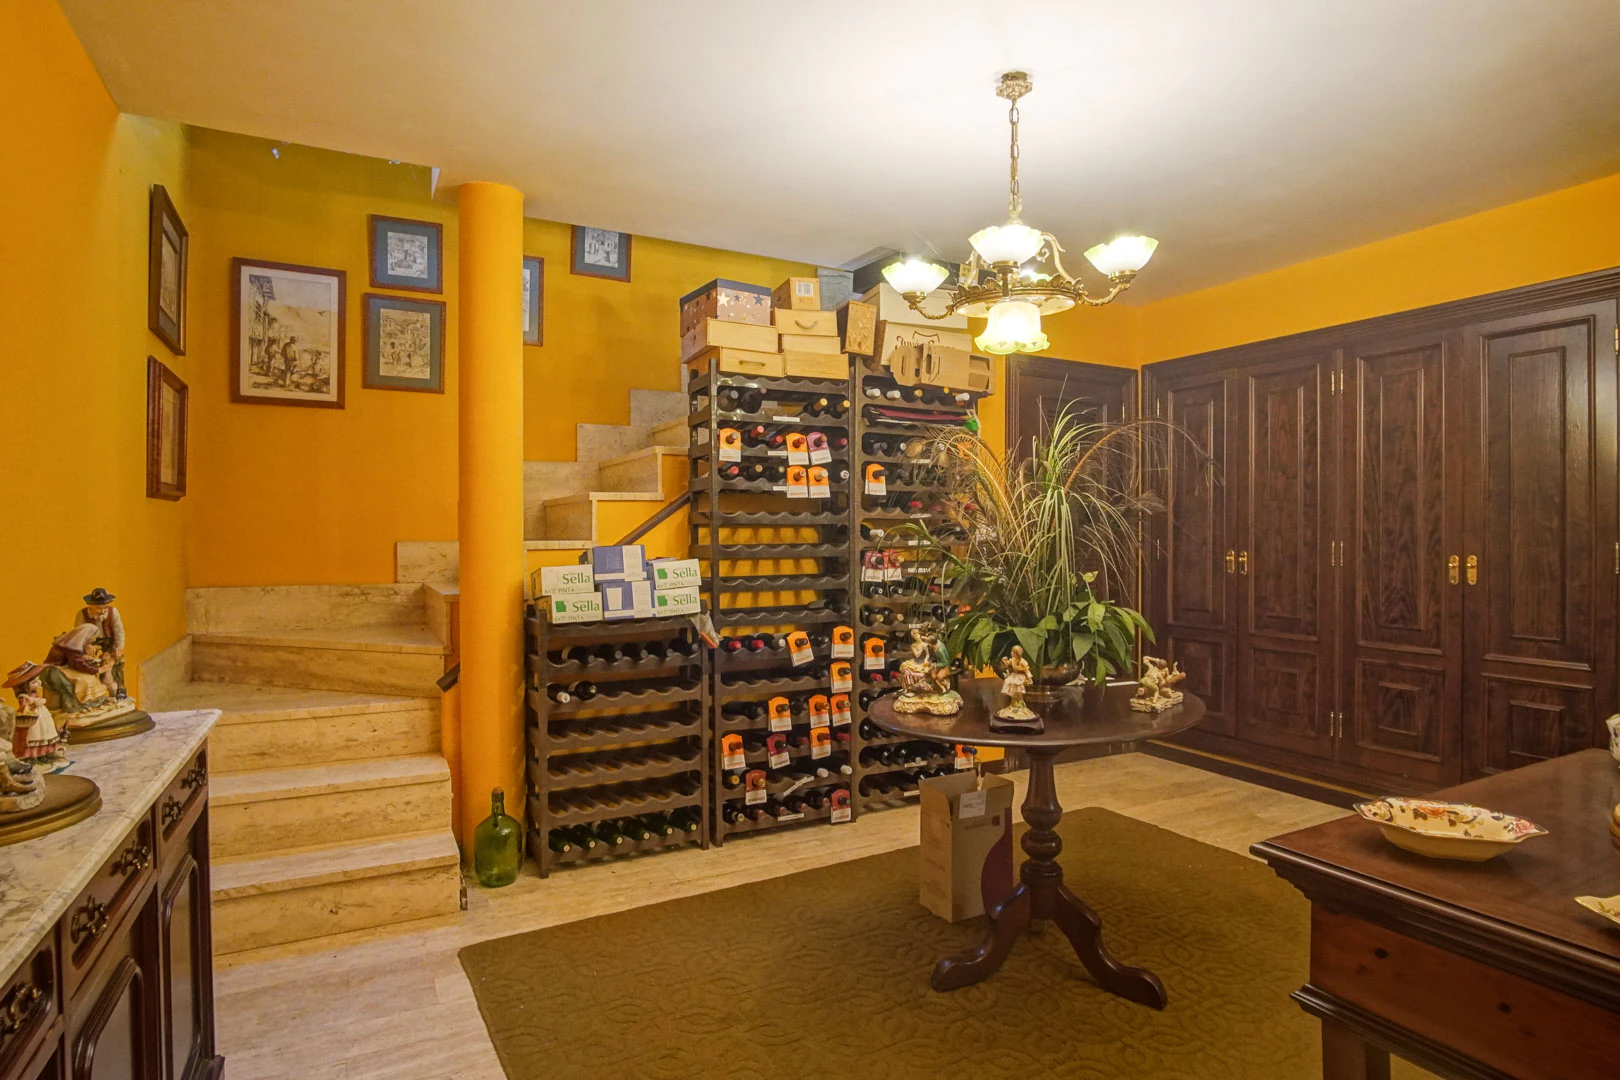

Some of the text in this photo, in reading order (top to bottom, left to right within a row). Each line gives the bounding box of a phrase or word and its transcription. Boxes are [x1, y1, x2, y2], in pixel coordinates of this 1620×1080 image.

[562, 572, 591, 585] Sella
[673, 567, 698, 579] Sella
[673, 594, 698, 606] Sella
[572, 600, 600, 613] Sella
